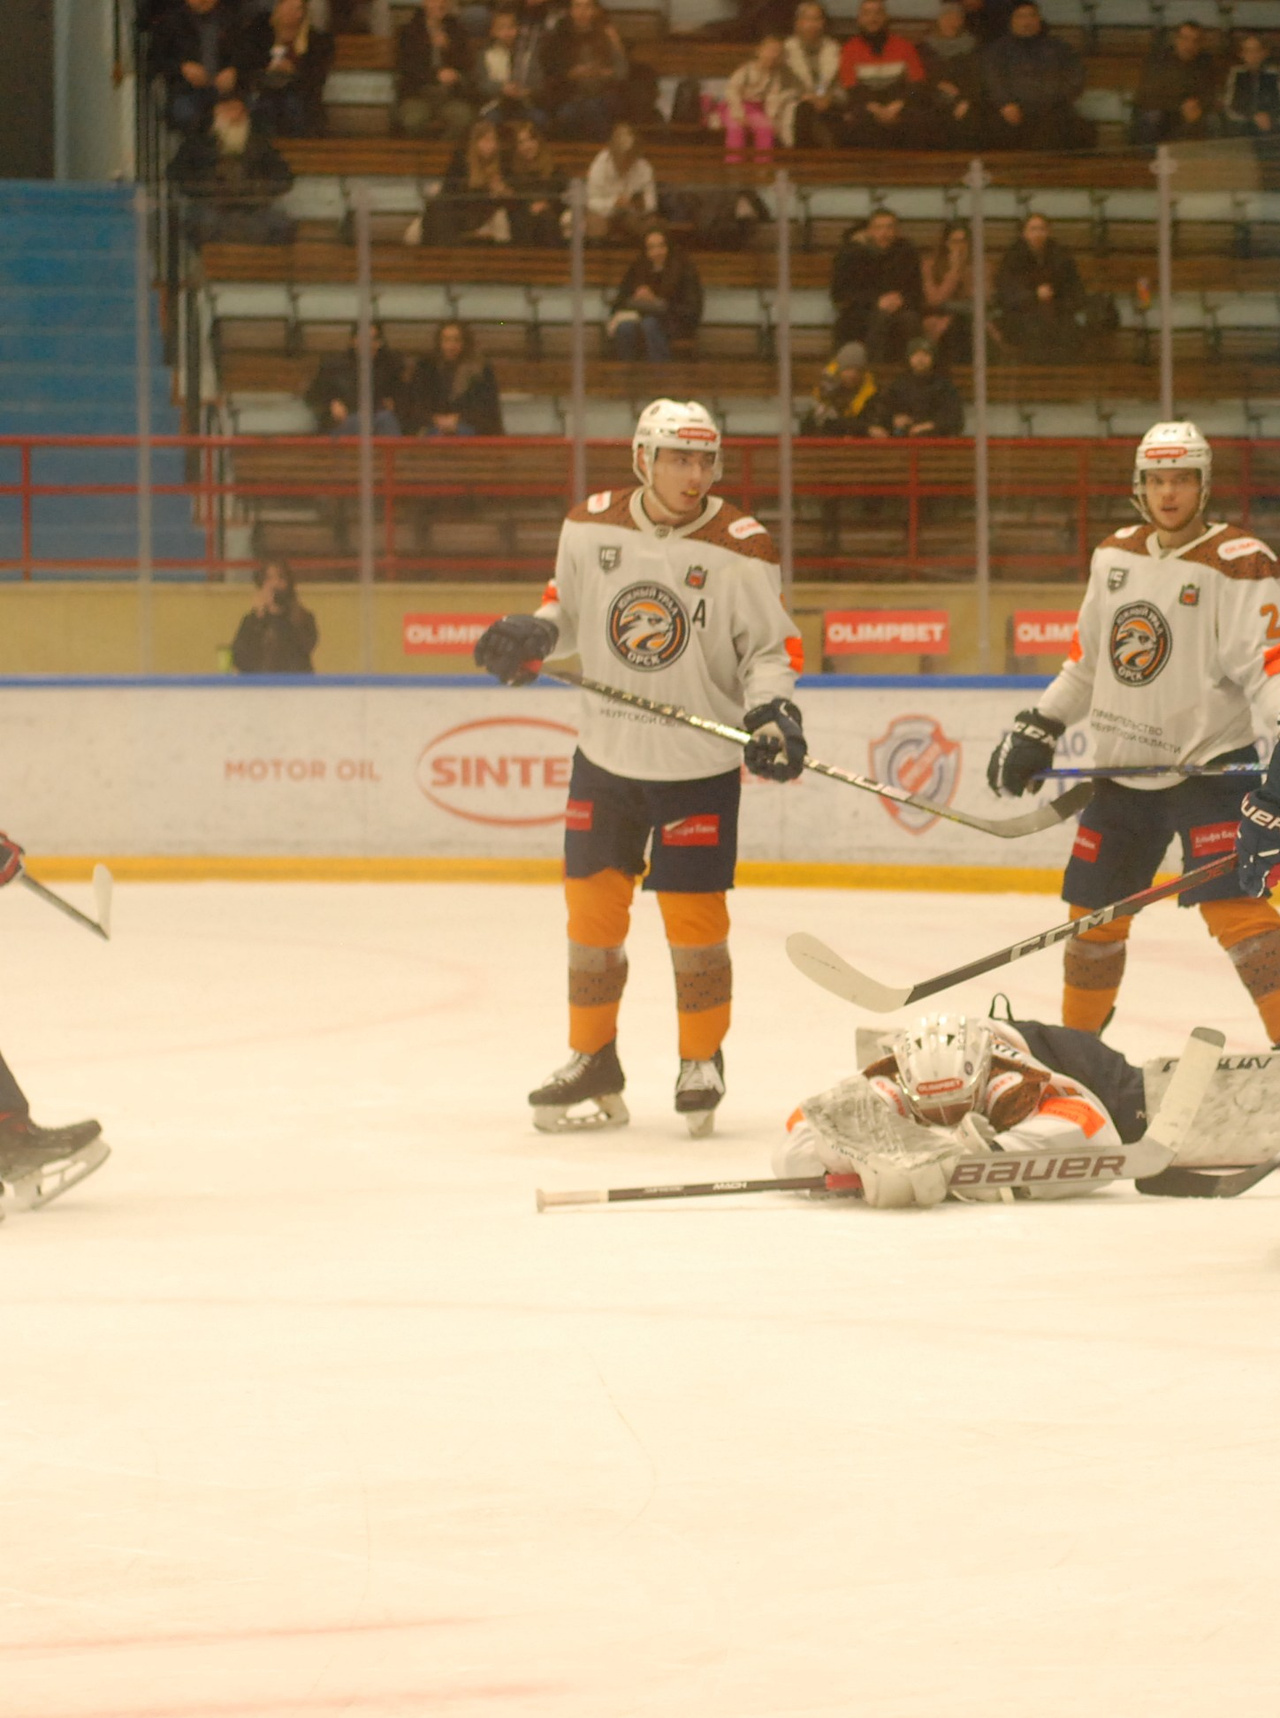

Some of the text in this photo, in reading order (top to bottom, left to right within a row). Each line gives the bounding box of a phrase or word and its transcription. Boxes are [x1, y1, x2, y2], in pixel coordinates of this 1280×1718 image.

[827, 622, 947, 642] OLIMPBET
[224, 759, 381, 783] MOTOR OIL
[430, 755, 571, 788] SINTE
[1010, 905, 1115, 963] CCM
